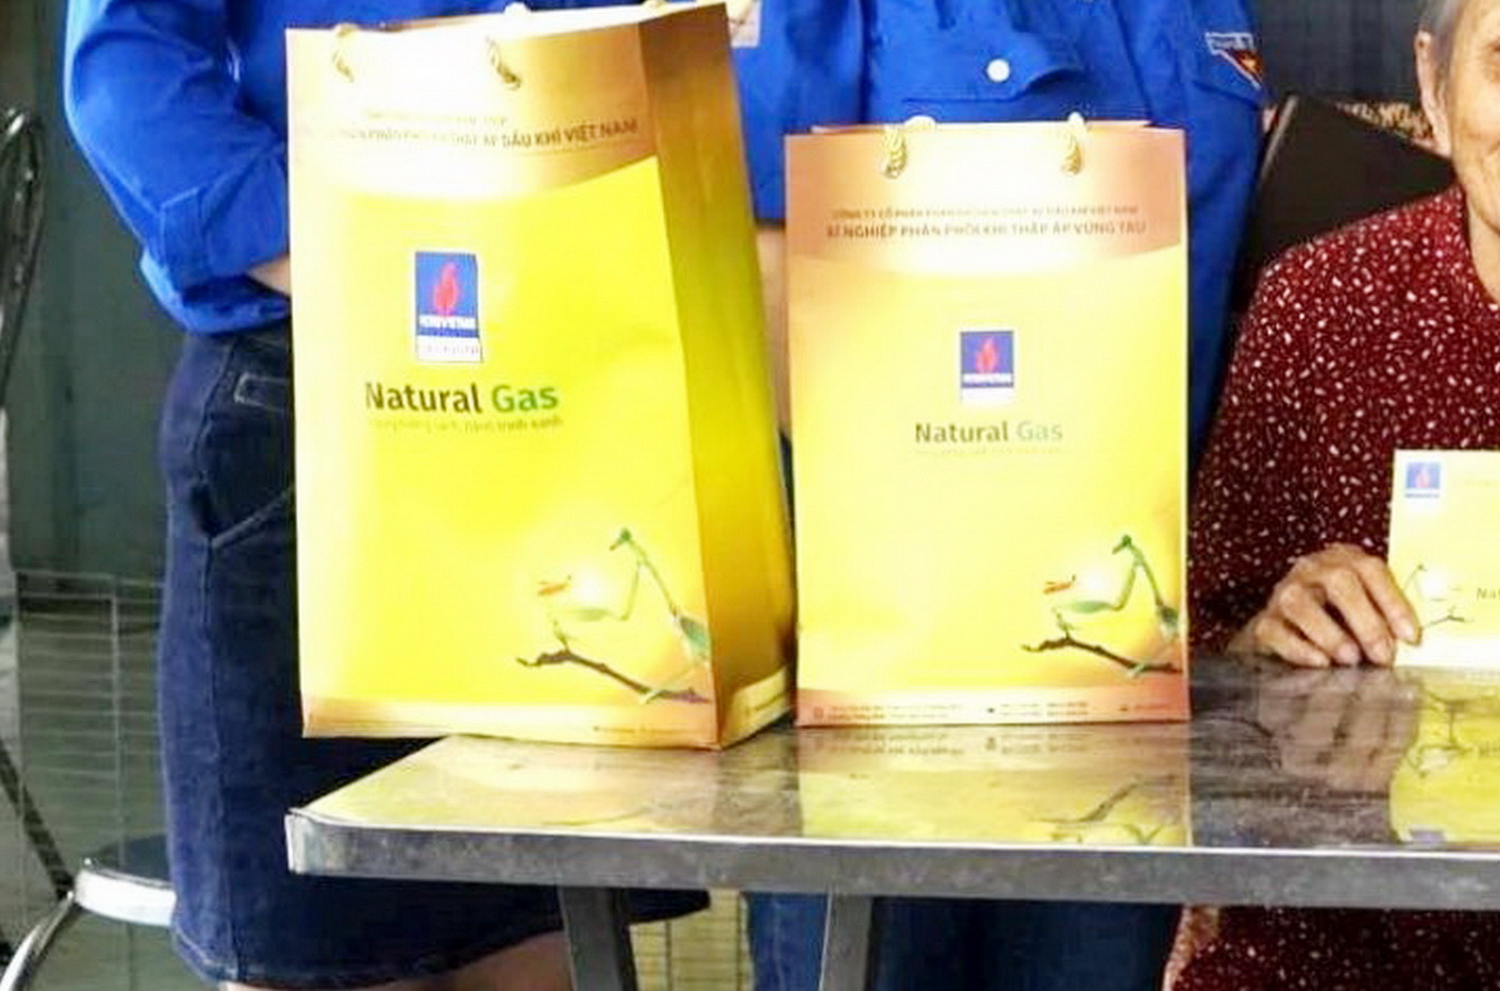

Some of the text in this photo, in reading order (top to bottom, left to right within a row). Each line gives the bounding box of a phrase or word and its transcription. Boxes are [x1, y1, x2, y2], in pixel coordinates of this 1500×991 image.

[365, 381, 559, 414] Natural Gas
[915, 420, 1063, 443] Natural Gas
